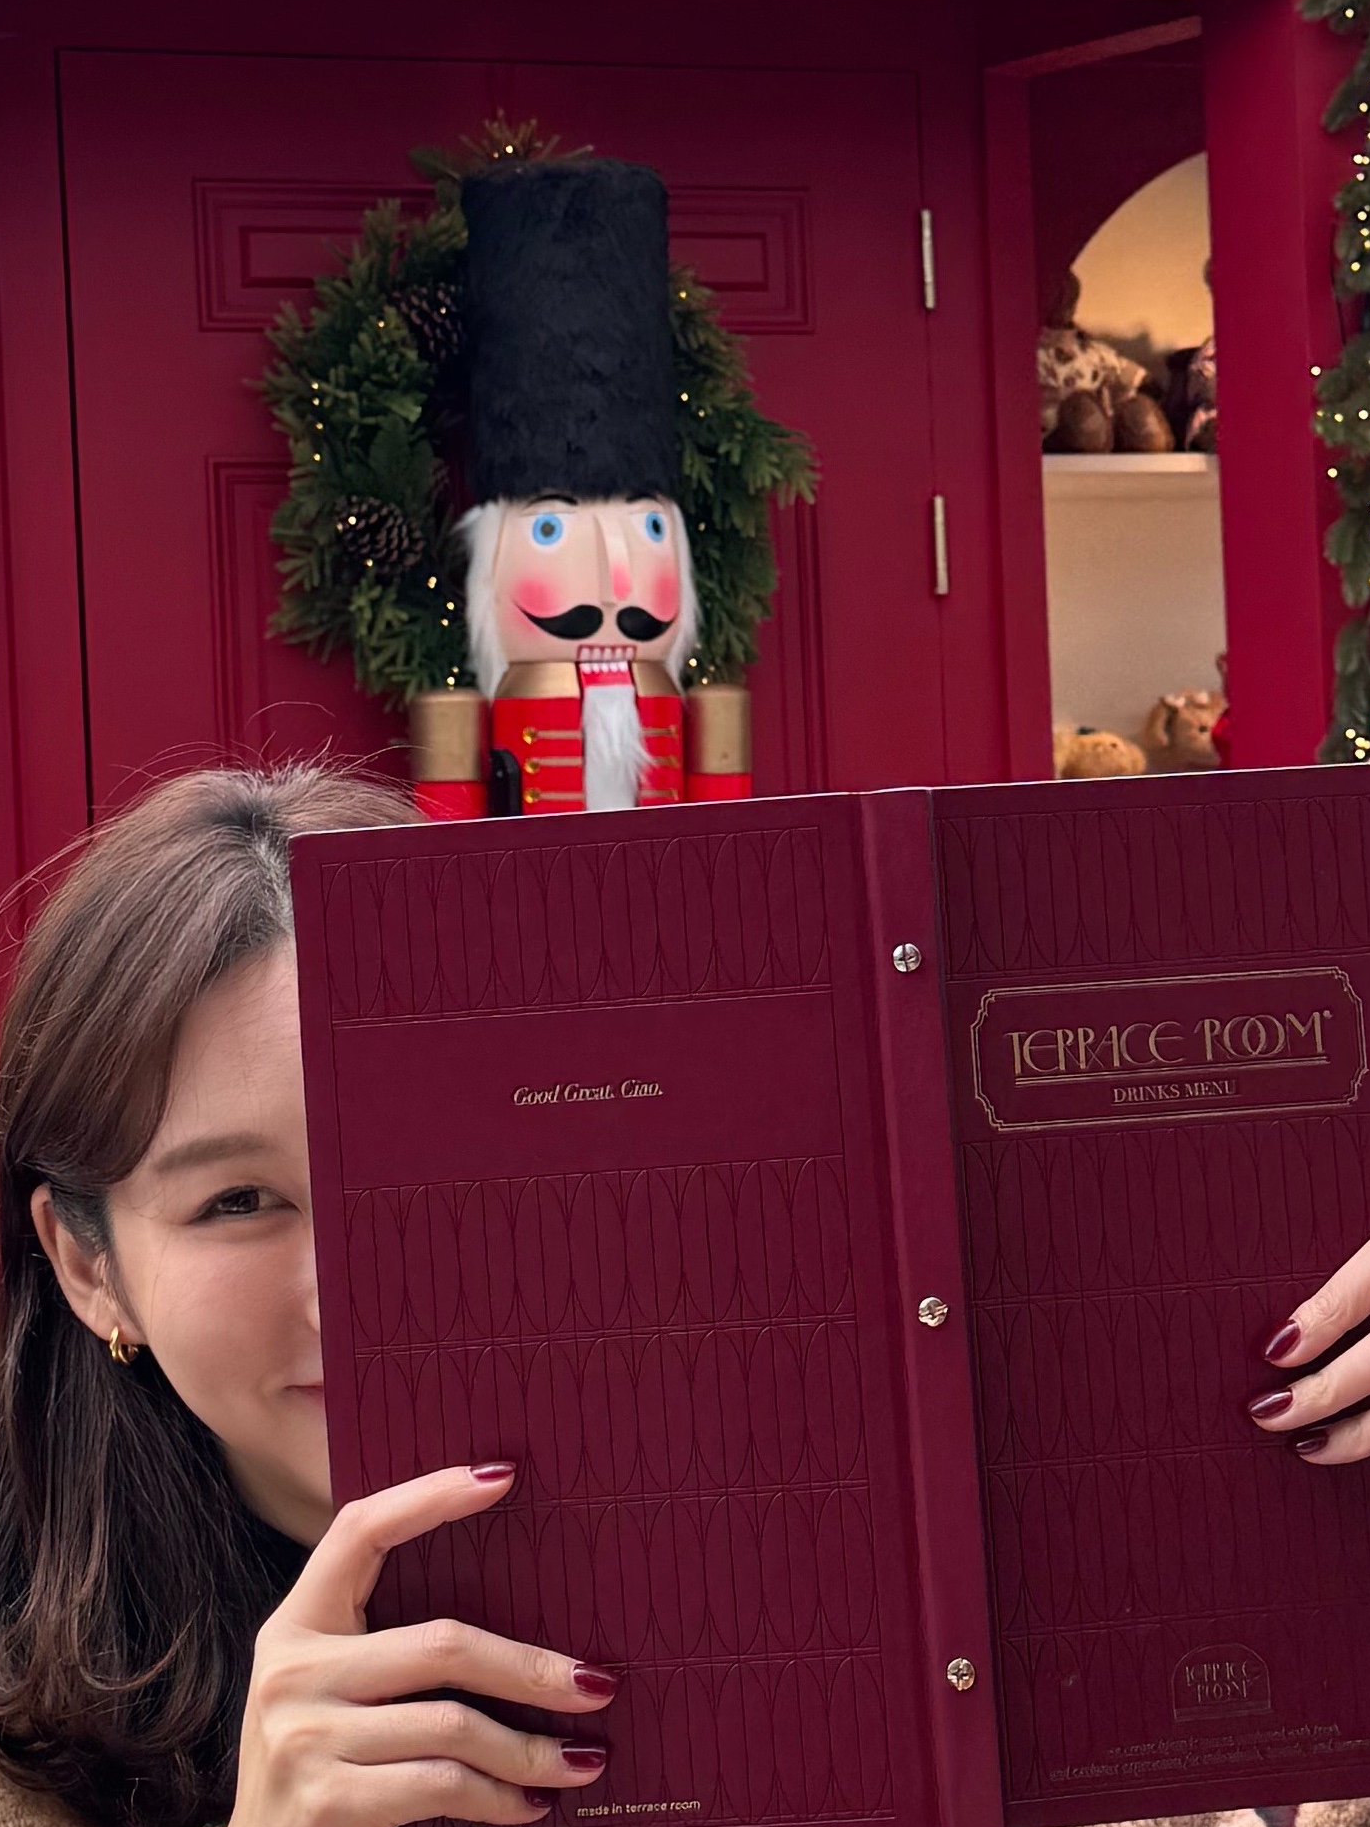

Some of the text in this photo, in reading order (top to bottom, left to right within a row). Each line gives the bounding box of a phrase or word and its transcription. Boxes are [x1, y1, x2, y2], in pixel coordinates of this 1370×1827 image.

[1005, 1011, 1324, 1076] TERRACE ROOM
[1111, 1078, 1239, 1104] DRINKS MENU
[611, 1803, 623, 1814] in
[626, 1802, 668, 1813] terrace
